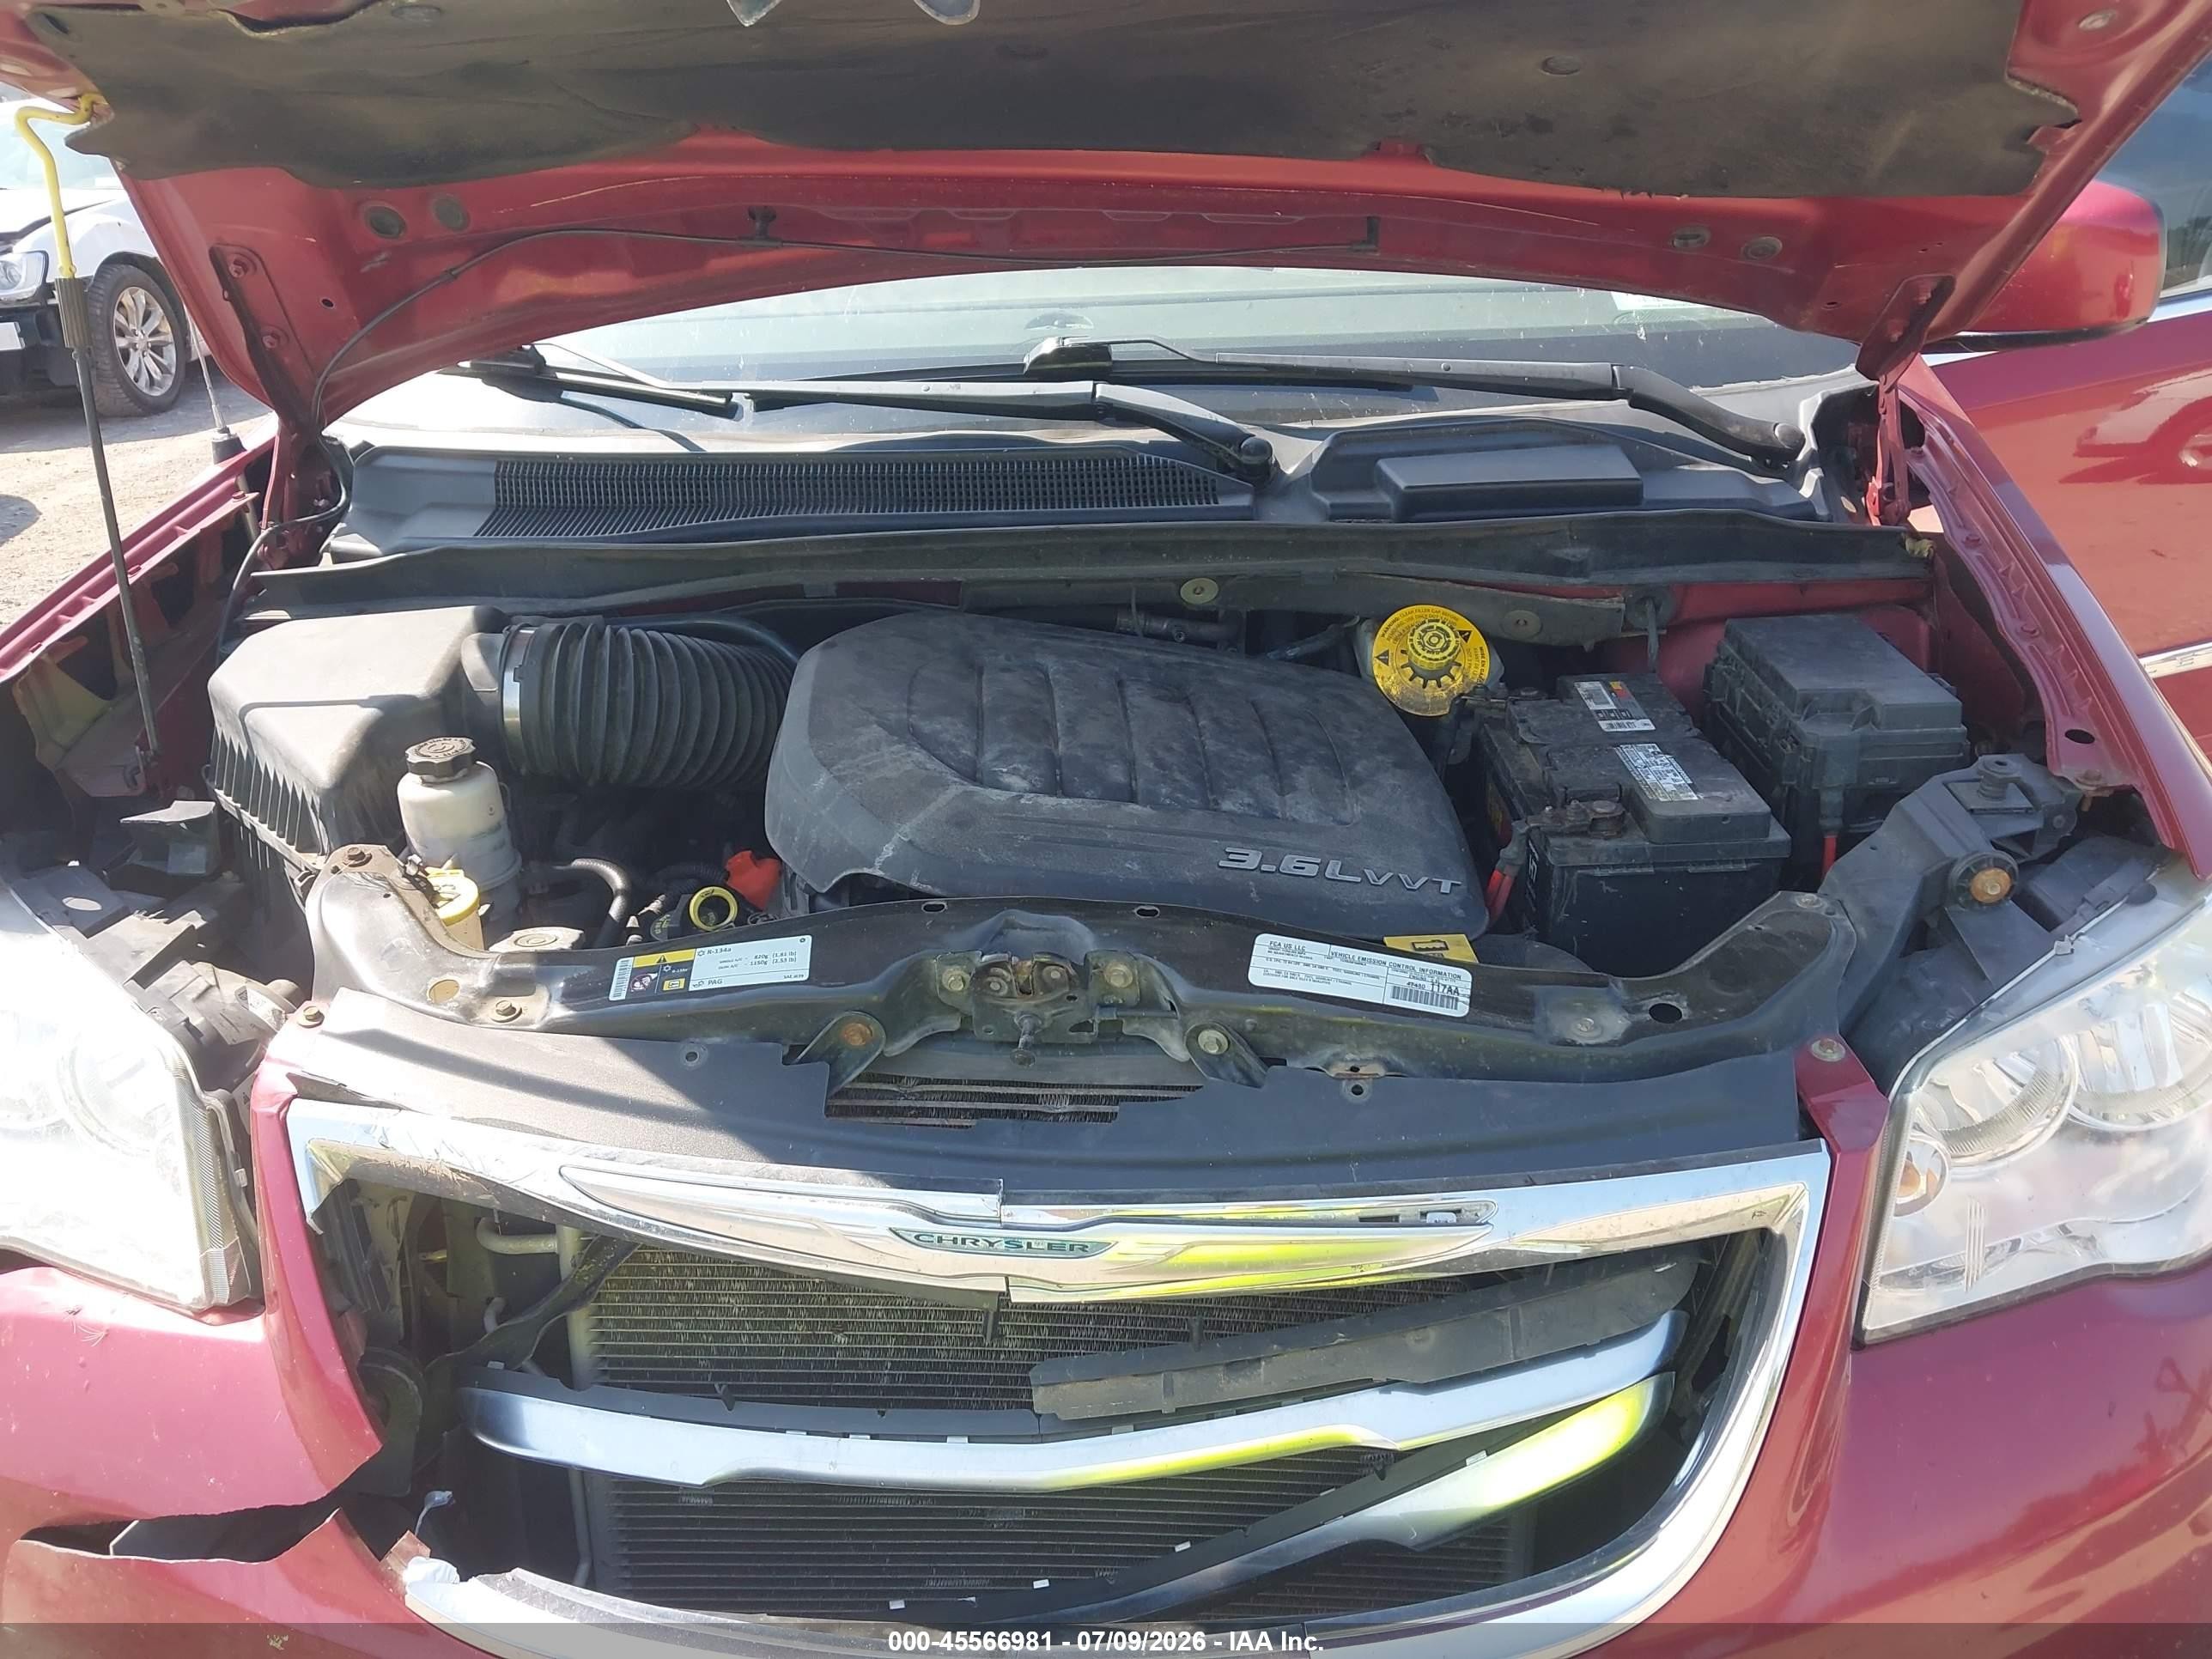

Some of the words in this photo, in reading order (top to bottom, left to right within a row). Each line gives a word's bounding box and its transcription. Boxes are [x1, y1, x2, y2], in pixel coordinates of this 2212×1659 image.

[1330, 951, 1356, 962] VEHICLE
[1357, 956, 1387, 966] EMISSION
[1389, 961, 1416, 972] CONTROL
[1419, 967, 1462, 980] INFORMATION
[914, 1233, 1091, 1253] CHRYSLER
